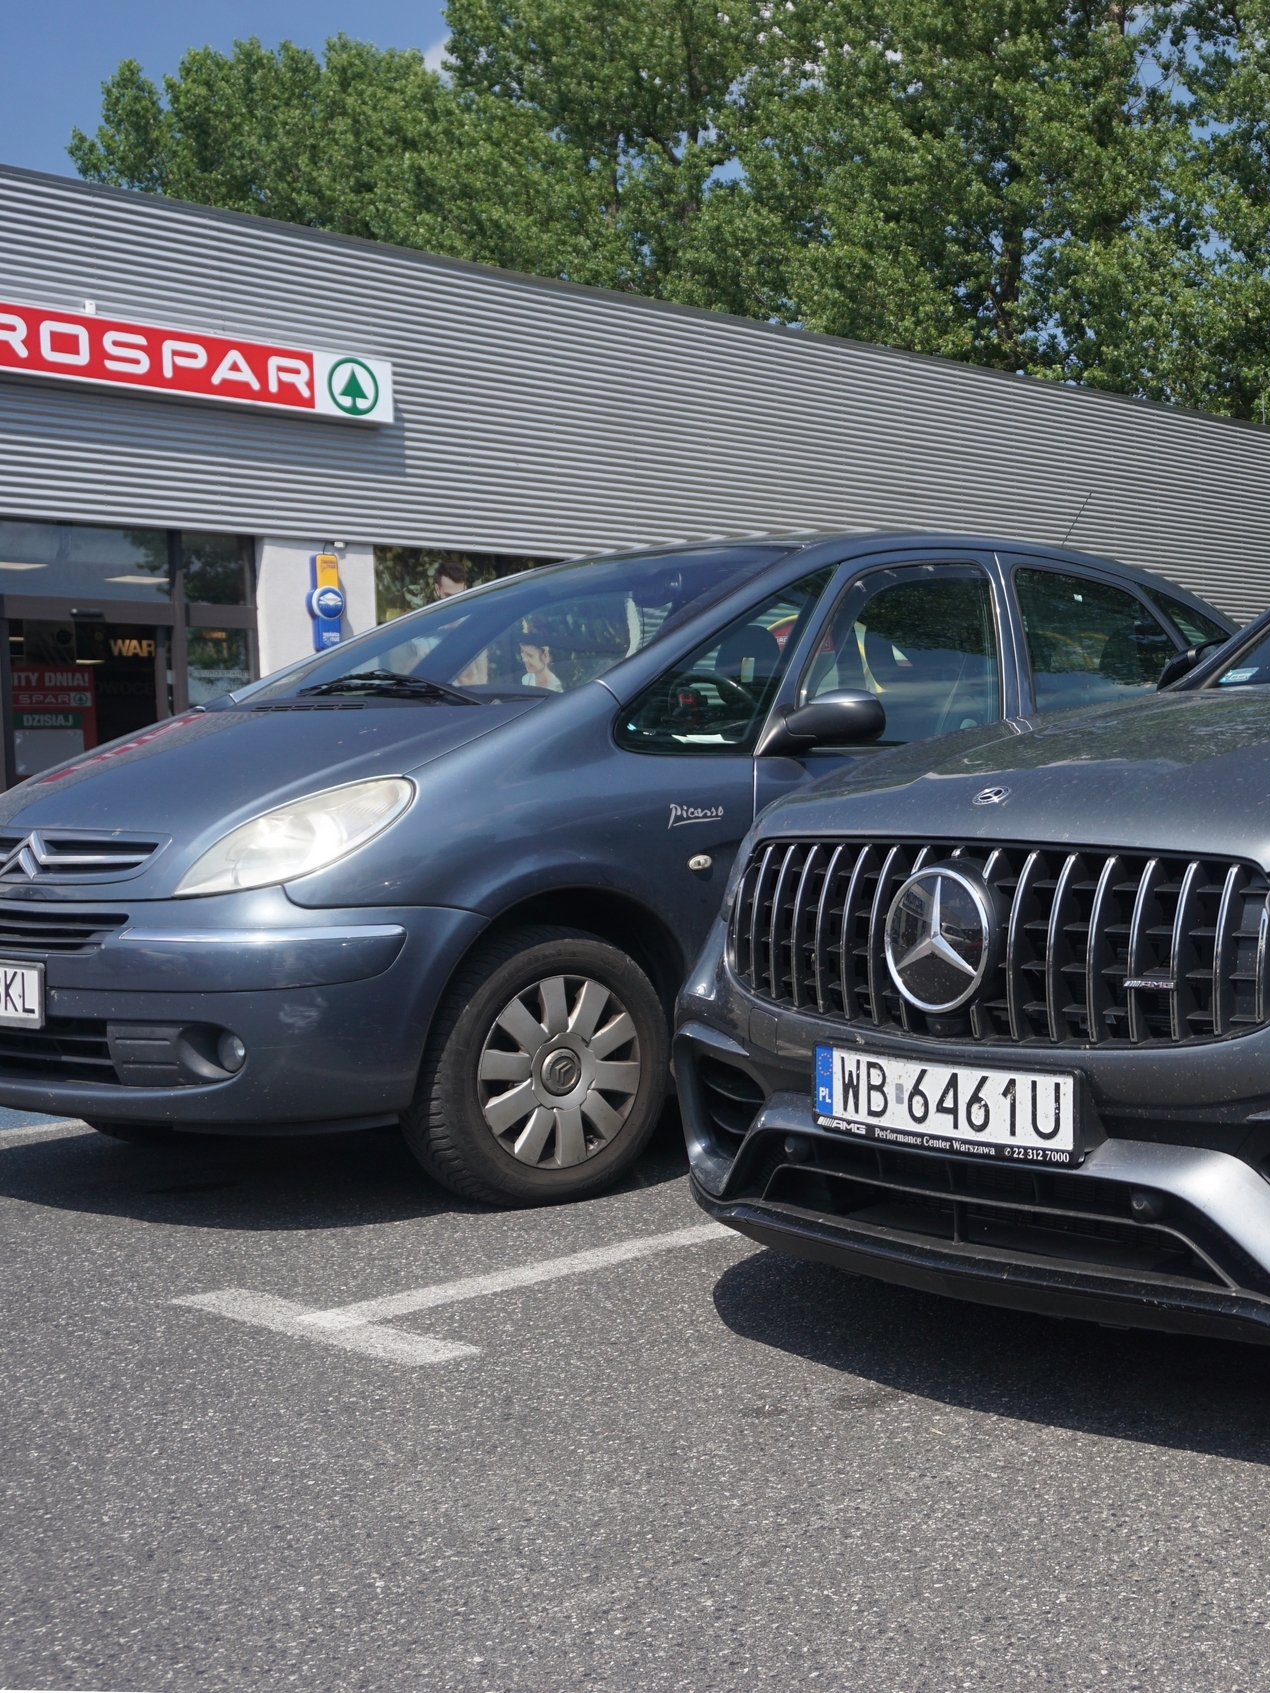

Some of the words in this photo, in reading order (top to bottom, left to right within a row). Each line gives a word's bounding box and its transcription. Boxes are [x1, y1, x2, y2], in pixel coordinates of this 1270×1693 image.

[0, 313, 311, 399] ROSPAR
[11, 672, 39, 686] ITY
[44, 673, 89, 687] DNIA!
[19, 694, 70, 704] SPAR
[23, 714, 73, 726] DZISIAJ
[668, 803, 724, 829] Picasso
[0, 970, 36, 1014] KL
[819, 1086, 832, 1104] PL
[840, 1056, 889, 1118] WB
[907, 1068, 1061, 1141] 6461U
[831, 1119, 867, 1135] AMG
[874, 1127, 922, 1144] Performance
[923, 1136, 951, 1150] Center
[952, 1140, 996, 1156] Warszawa
[1013, 1147, 1025, 1159] 22
[1027, 1149, 1044, 1160] 312
[1046, 1151, 1070, 1163] 7000
